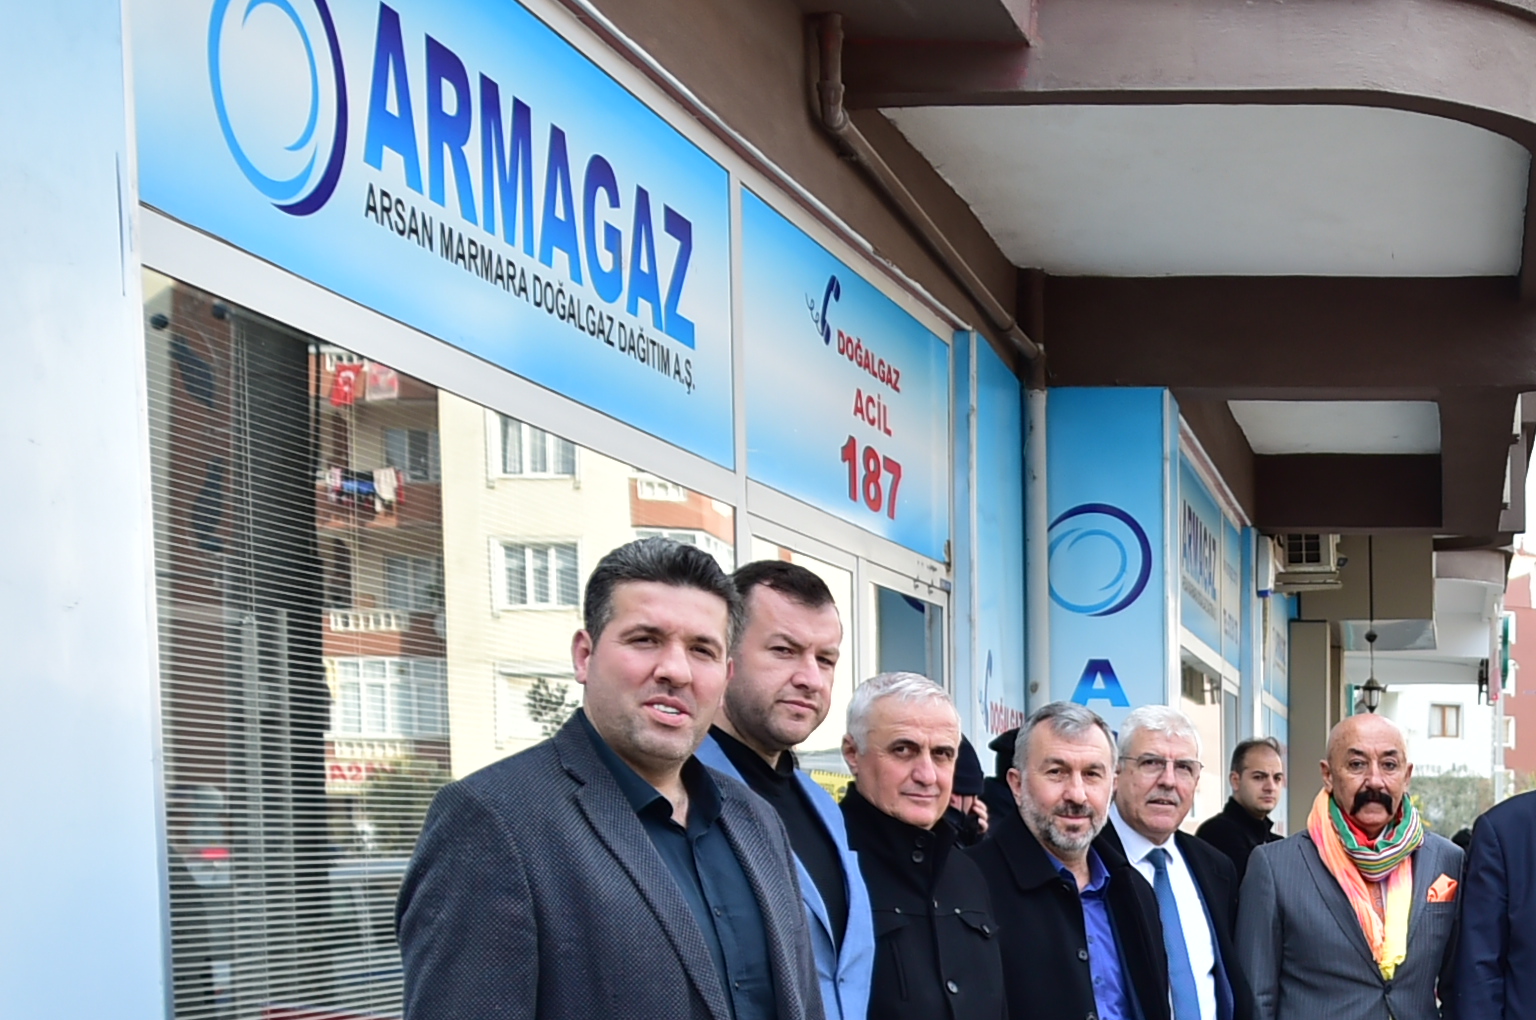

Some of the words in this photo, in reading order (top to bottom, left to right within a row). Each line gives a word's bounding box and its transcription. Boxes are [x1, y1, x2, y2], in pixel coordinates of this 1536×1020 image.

[363, 1, 696, 350] ARMAGAZ
[364, 182, 434, 252] ARSAN
[439, 222, 530, 303] MARMARA
[532, 273, 617, 348] DOĞALGAZ
[617, 320, 672, 378] DAĞITIM
[672, 347, 697, 395] A.Ş.
[837, 328, 901, 393] DOĞALGAZ
[852, 388, 893, 437] ACİL
[840, 434, 903, 521] 187
[1182, 499, 1217, 602] ARMAGAZ
